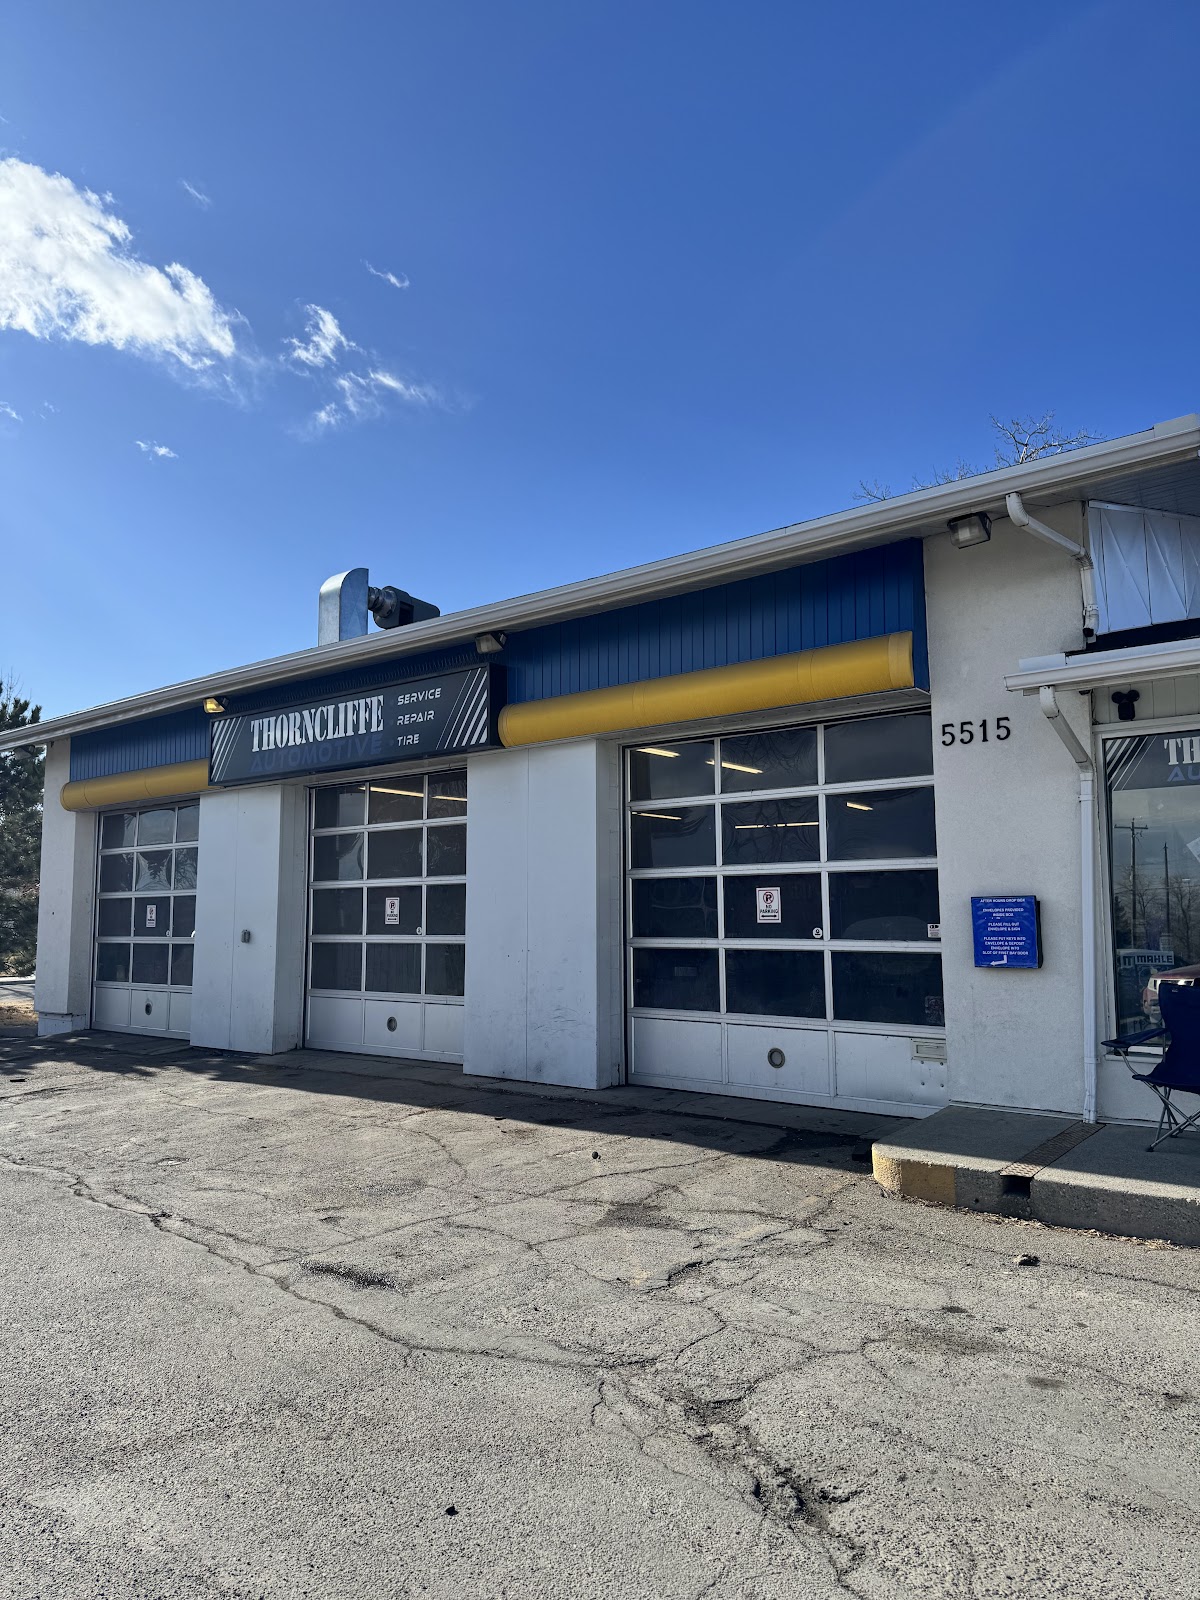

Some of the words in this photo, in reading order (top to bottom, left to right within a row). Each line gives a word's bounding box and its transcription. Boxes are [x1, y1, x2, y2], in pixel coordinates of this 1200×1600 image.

[397, 687, 442, 706] SERVICE
[250, 695, 384, 753] THORNCLIFFE
[397, 710, 435, 726] REPAIR
[397, 733, 420, 747] TIRE
[941, 716, 1011, 747] 5515
[250, 733, 383, 772] AUTOMOTIVE
[1136, 955, 1173, 963] MAHLE
